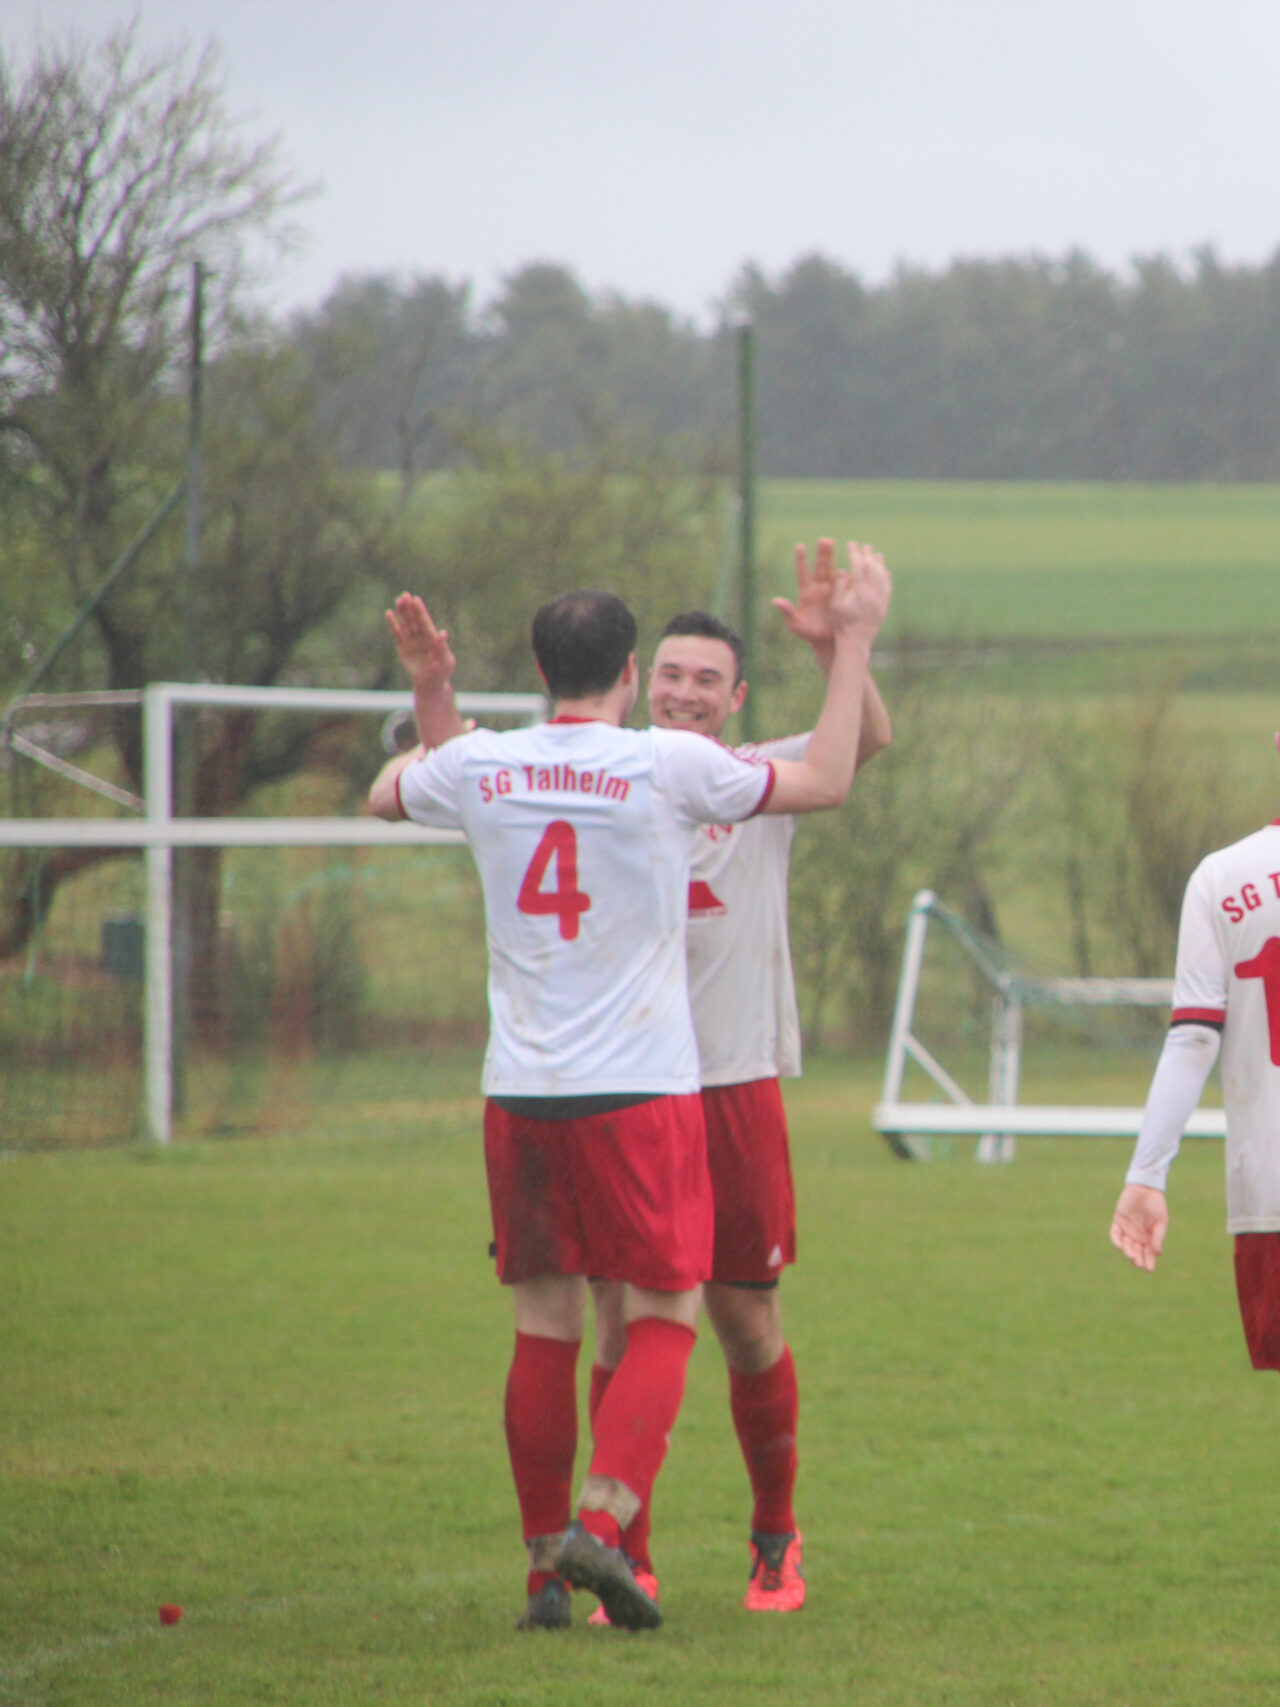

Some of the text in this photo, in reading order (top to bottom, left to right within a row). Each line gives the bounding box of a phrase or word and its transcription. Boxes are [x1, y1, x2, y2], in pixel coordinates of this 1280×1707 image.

[478, 763, 631, 803] SG Talheim
[516, 819, 592, 942] 4
[1221, 882, 1263, 924] SG
